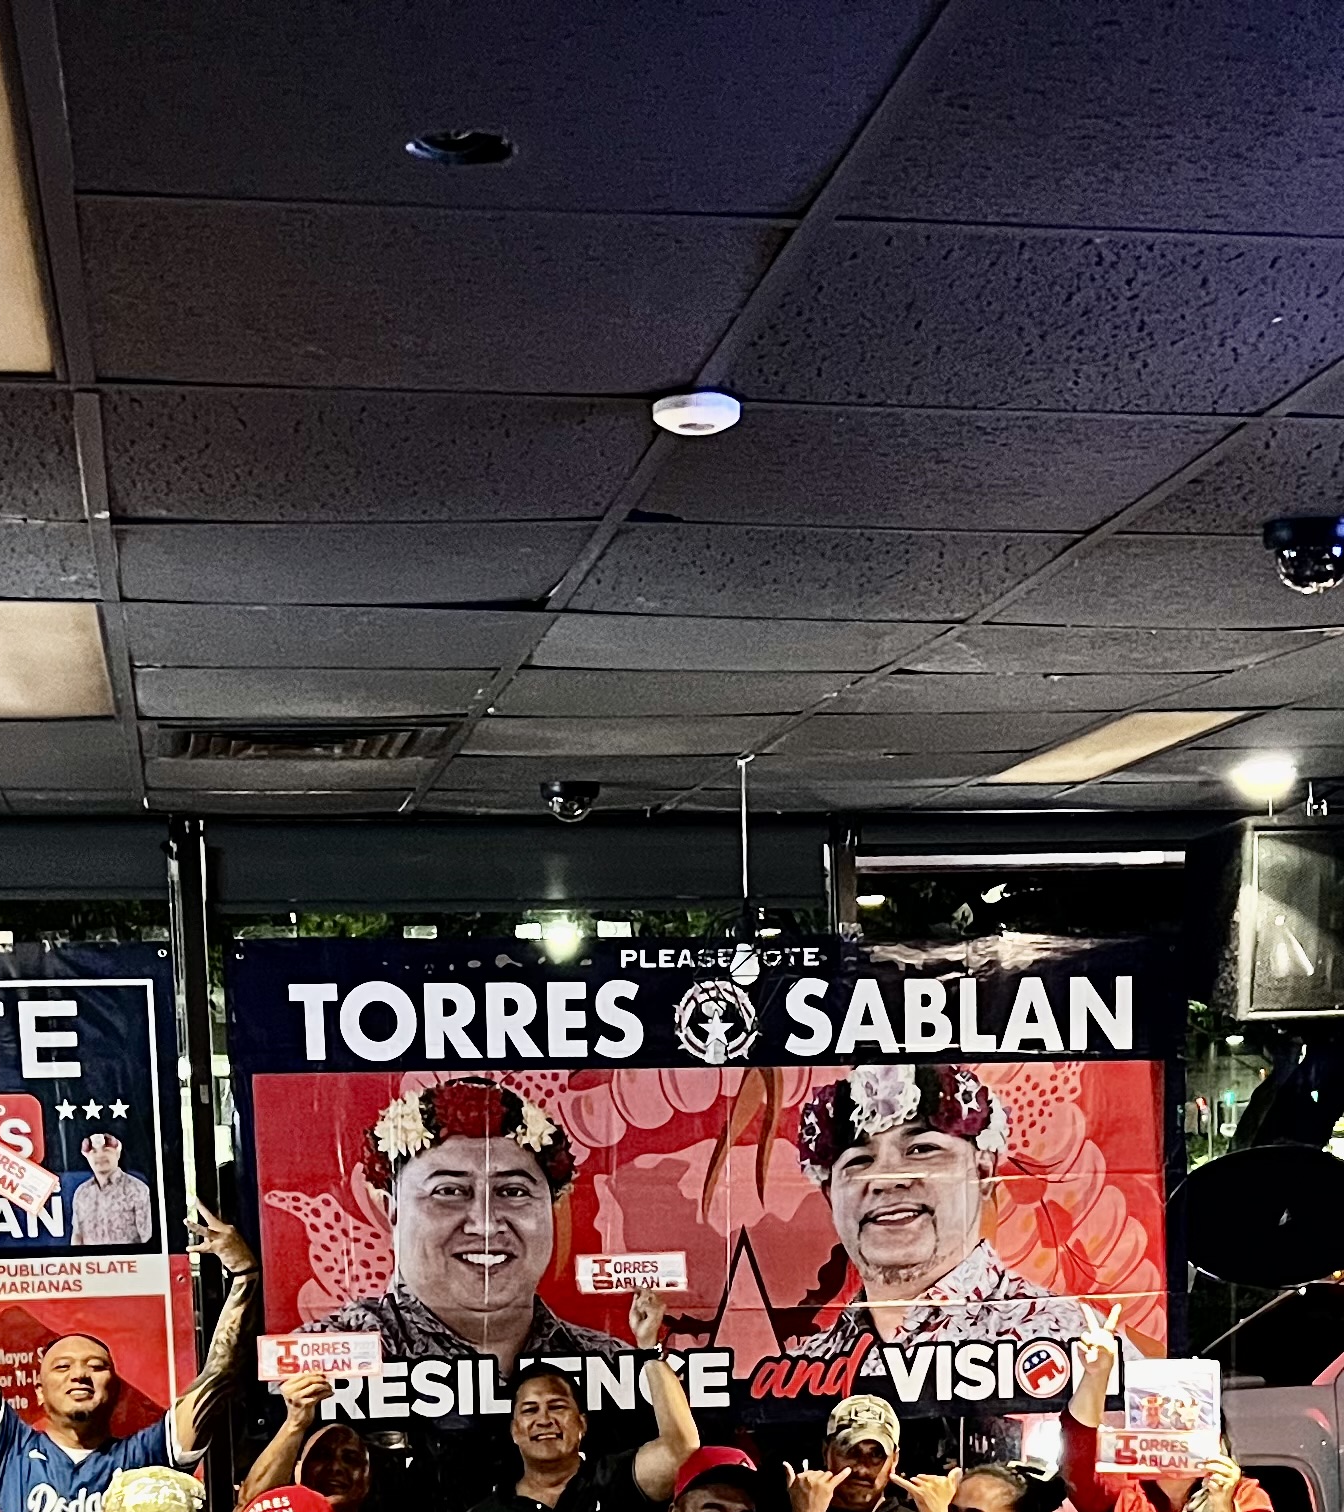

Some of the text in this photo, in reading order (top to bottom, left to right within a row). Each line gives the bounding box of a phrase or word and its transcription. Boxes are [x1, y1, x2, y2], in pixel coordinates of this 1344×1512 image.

[620, 948, 820, 968] PLEASE OTE
[289, 976, 1133, 1061] TORRES SABLAN
[85, 1260, 138, 1275] SLATE
[592, 1258, 659, 1275] TORRES
[276, 1340, 352, 1361] TORRES
[276, 1355, 353, 1374] SABLAN
[751, 1333, 874, 1399] and
[1114, 1435, 1189, 1454] TORRES
[1114, 1450, 1189, 1469] SABLAN
